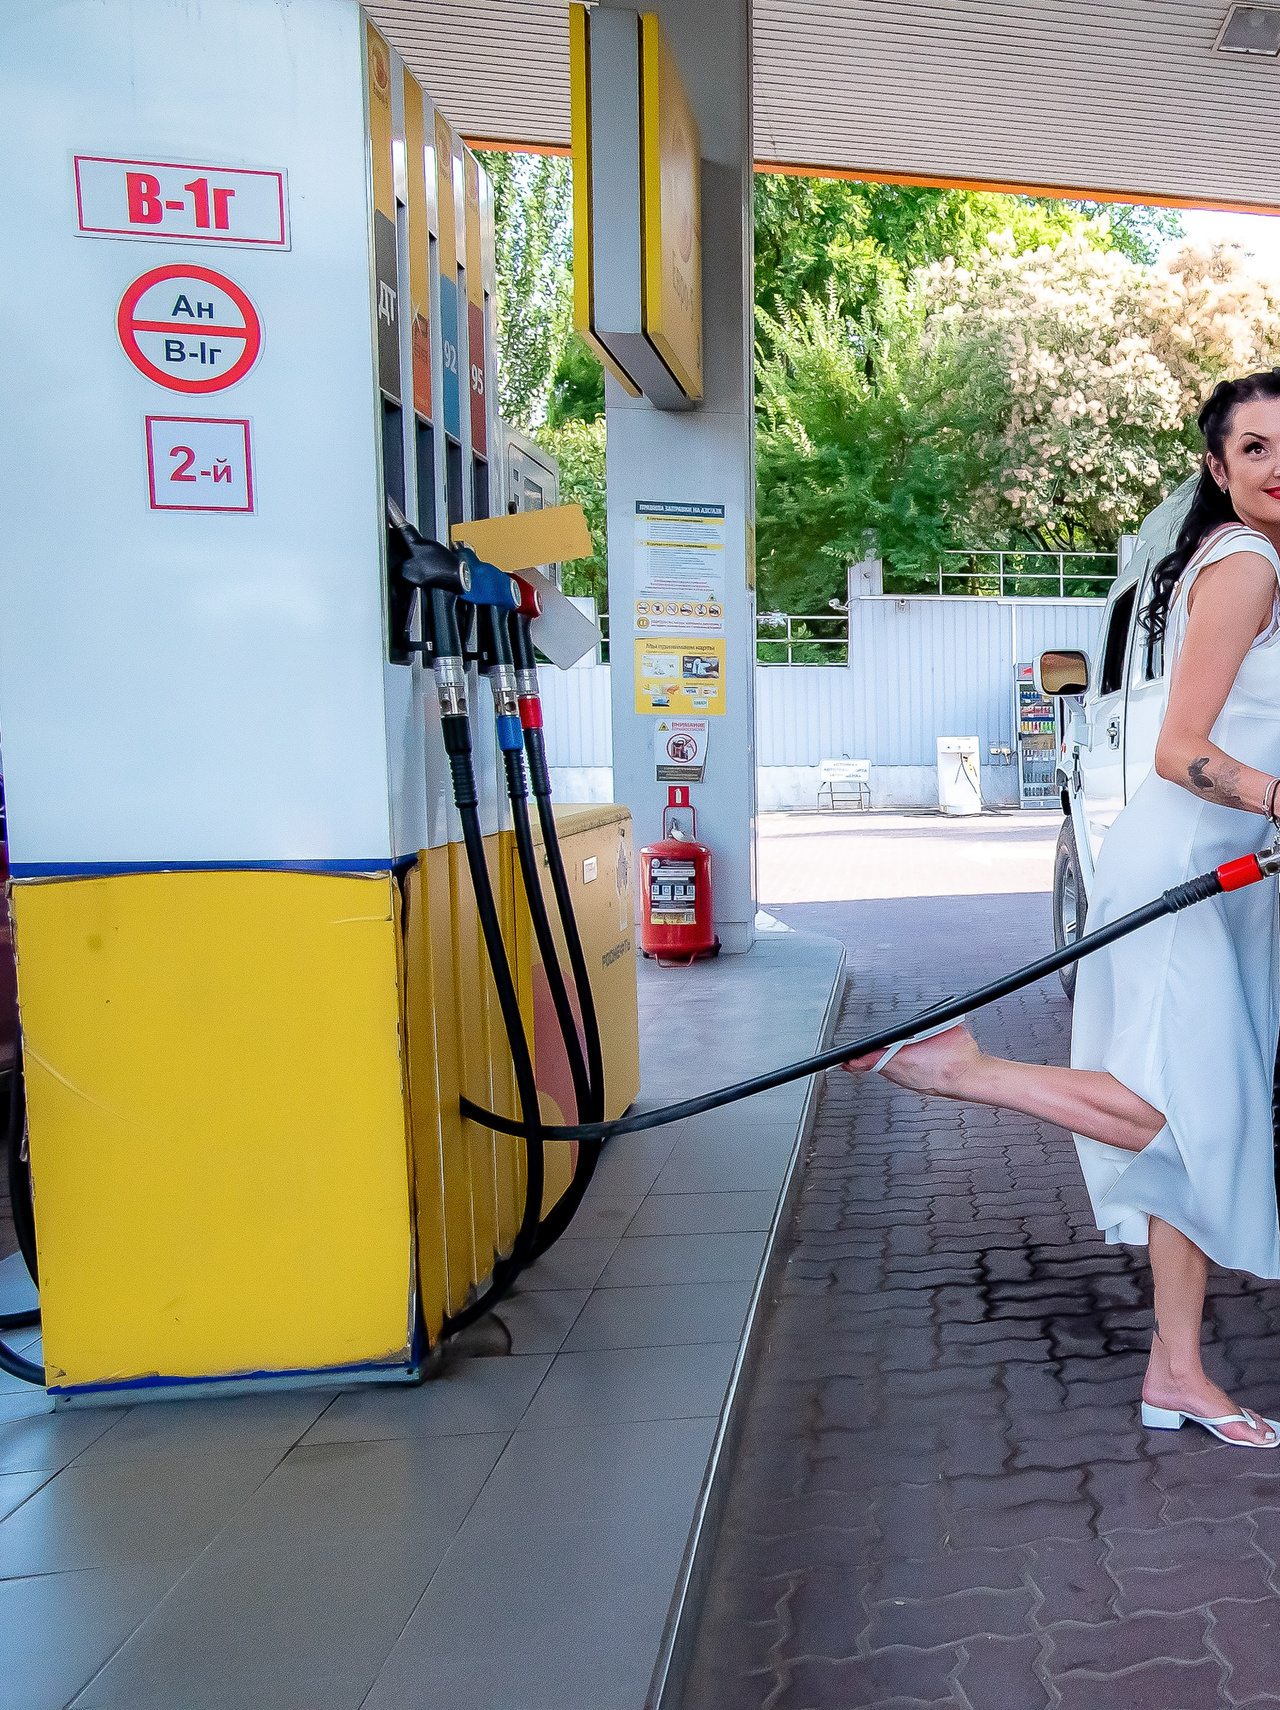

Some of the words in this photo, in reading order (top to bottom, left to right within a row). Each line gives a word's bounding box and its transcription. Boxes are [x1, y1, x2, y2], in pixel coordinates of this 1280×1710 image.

[171, 294, 214, 319] Ан
[378, 279, 396, 327] ДТ
[444, 339, 457, 375] 92
[471, 363, 484, 395] 95
[168, 445, 232, 484] 2-й
